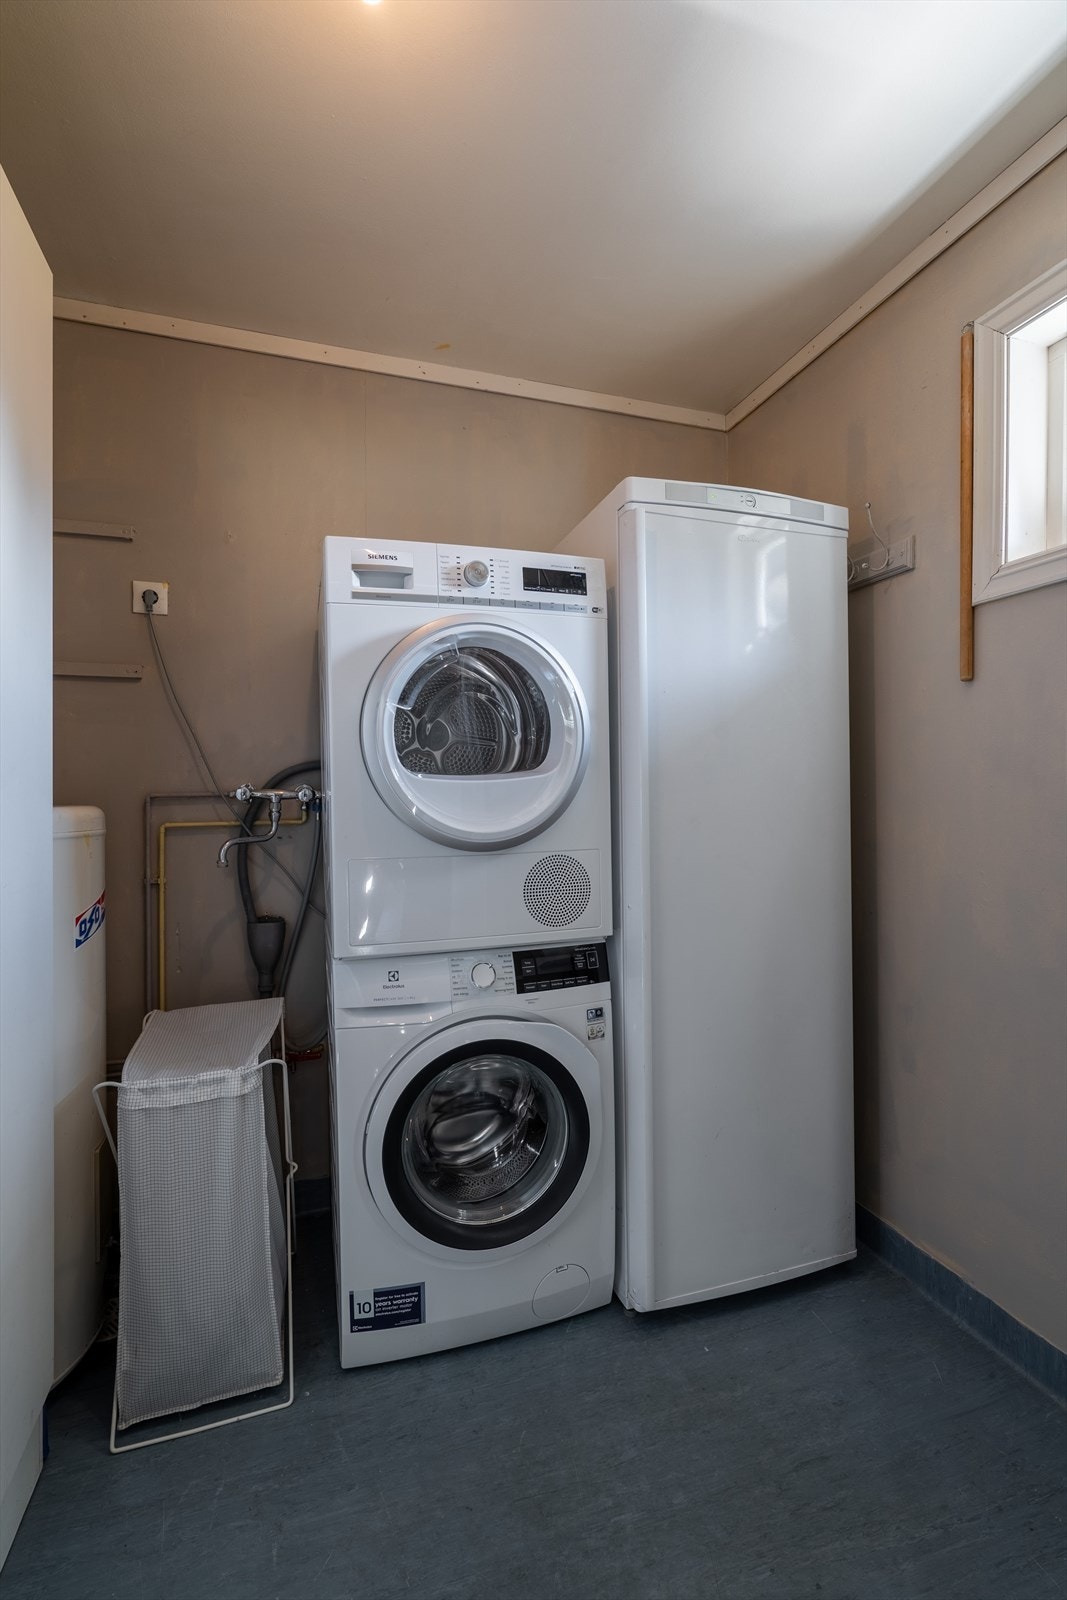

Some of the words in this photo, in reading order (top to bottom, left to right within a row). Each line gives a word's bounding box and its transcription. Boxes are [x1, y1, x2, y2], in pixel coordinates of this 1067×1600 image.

[367, 553, 398, 561] SIEMENS
[392, 1296, 419, 1304] warranty
[356, 1301, 372, 1315] 10
